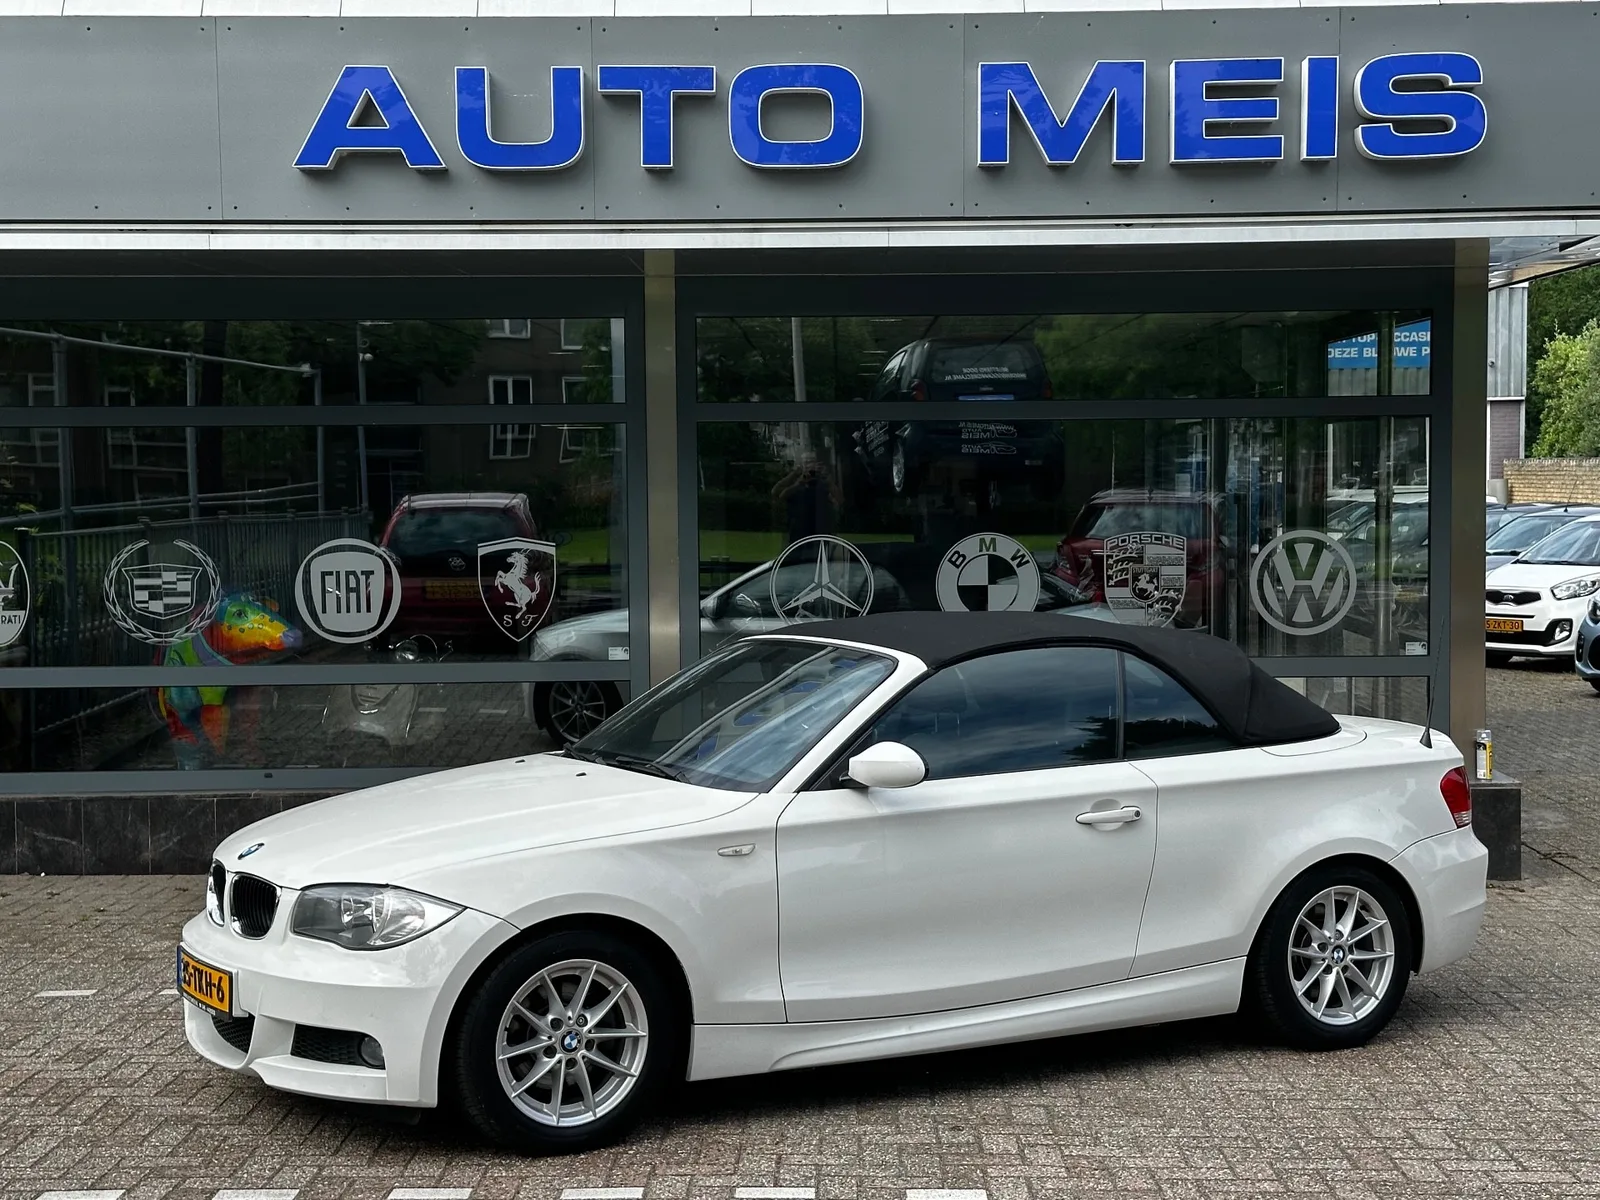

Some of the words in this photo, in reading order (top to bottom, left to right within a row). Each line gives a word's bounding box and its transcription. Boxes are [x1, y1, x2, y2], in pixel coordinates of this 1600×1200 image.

[292, 63, 864, 169] AUTO
[977, 51, 1488, 166] MEIS
[1328, 347, 1358, 358] DEZE
[947, 537, 1030, 569] BMW
[1107, 534, 1184, 551] PORSCHE
[320, 570, 375, 614] FIAT
